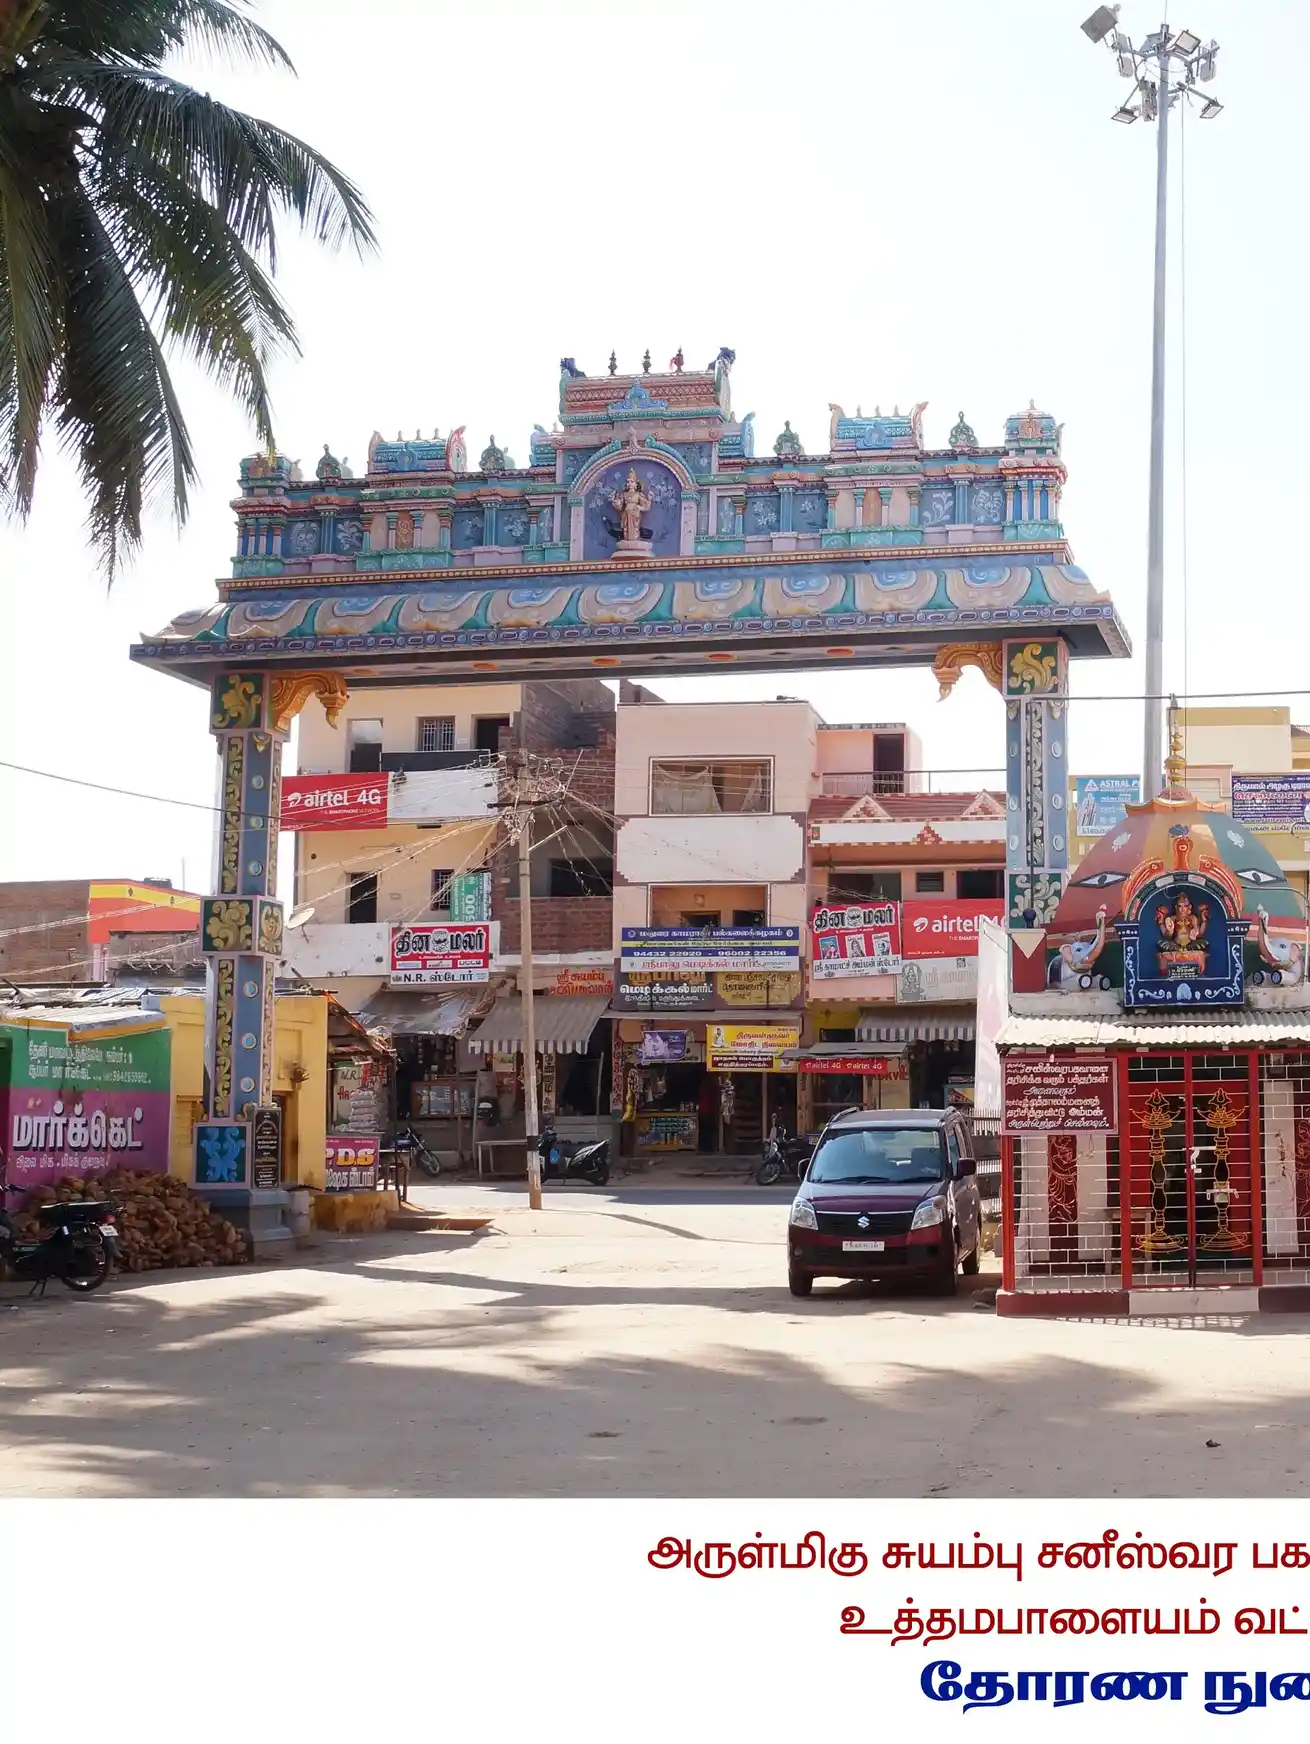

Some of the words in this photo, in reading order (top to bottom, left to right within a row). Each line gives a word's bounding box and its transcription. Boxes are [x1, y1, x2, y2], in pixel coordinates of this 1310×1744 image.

[303, 789, 349, 807] airtel
[357, 788, 381, 805] 4G
[931, 914, 979, 933] airtel
[403, 973, 427, 983] N.R.
[430, 970, 474, 983] ஸ்டோர்
[619, 982, 691, 996] மெடிக்கல்
[811, 1060, 830, 1069] airtel
[831, 1059, 841, 1069] 4G
[852, 1060, 870, 1070] airtel
[872, 1061, 883, 1071] 4G
[1043, 1074, 1065, 1085] வரும்
[1068, 1073, 1109, 1085] பக்தர்கள்
[1068, 1106, 1104, 1117] அம்மன்
[12, 1100, 144, 1149] மார்க்கெட்
